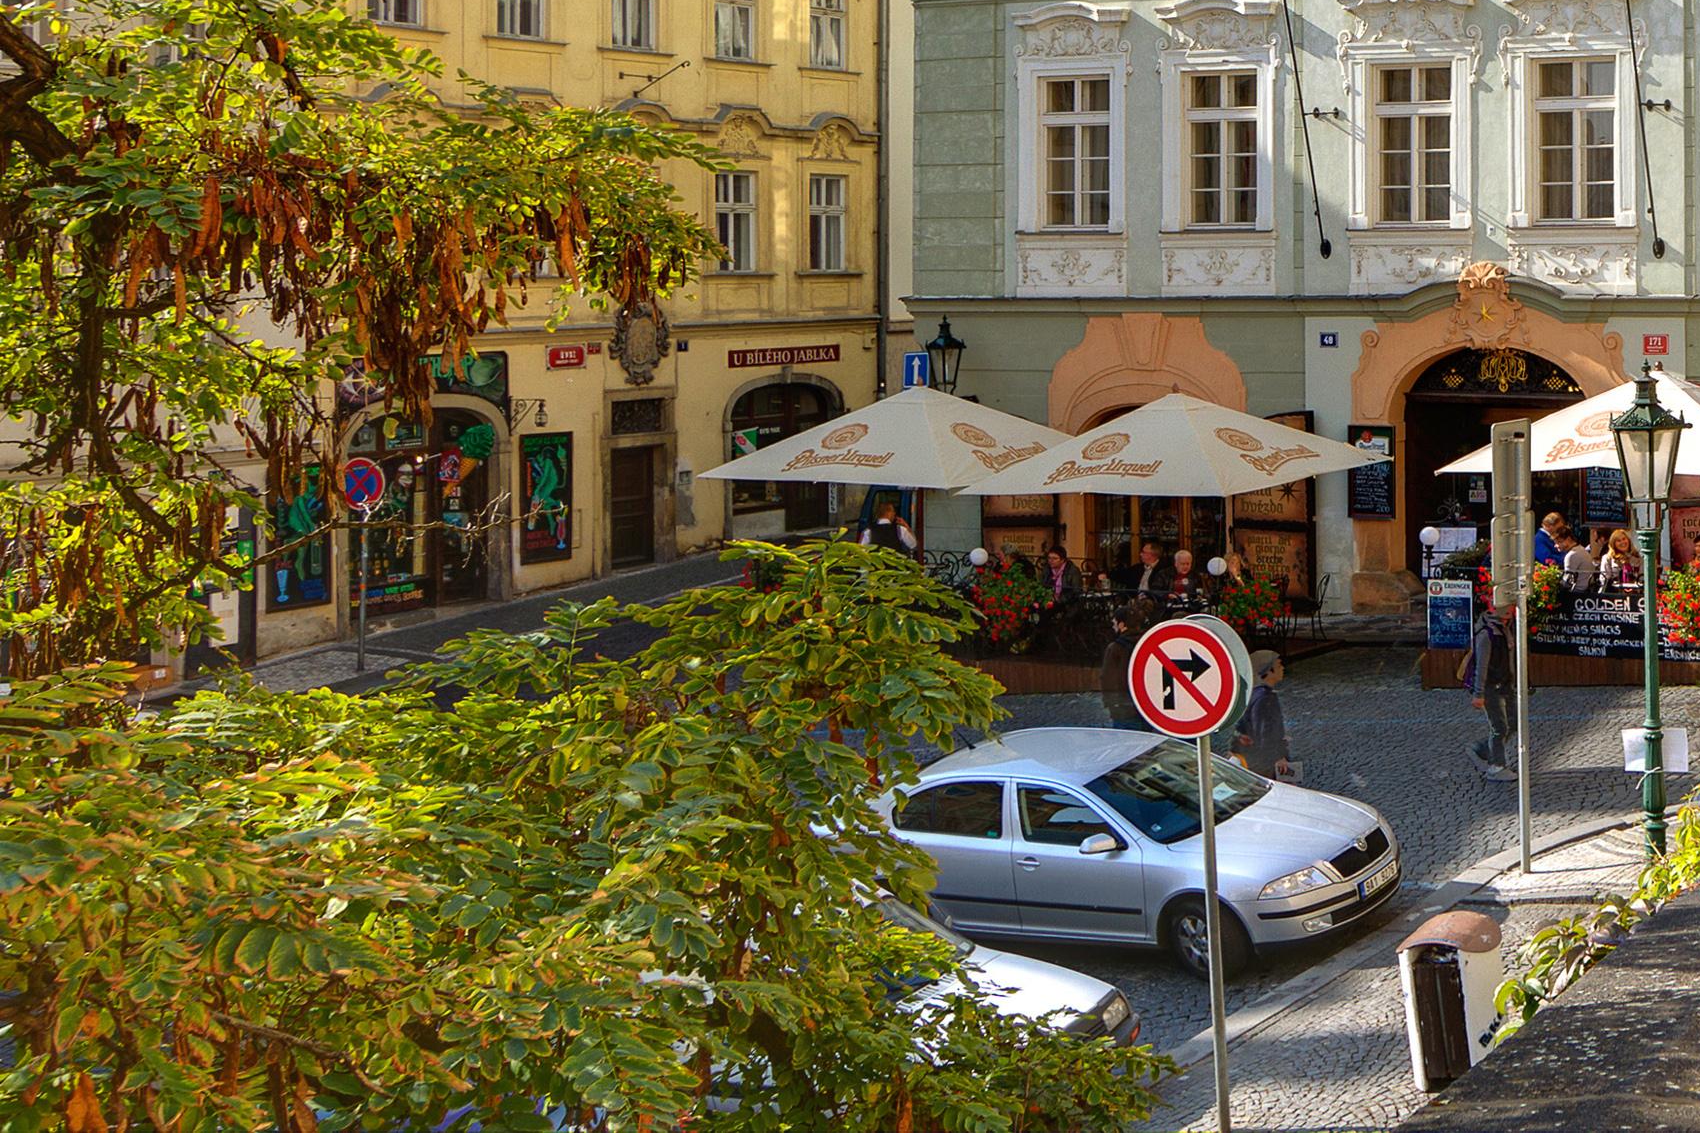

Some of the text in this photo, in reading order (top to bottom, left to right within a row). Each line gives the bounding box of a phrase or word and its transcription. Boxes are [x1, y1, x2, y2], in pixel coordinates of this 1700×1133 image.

[1323, 335, 1334, 345] 48
[1649, 336, 1662, 346] 171
[734, 347, 836, 365] U BÍLÉHO JABLKA
[1545, 438, 1613, 464] Pilsner
[781, 449, 894, 472] Pilsner Urquell
[1043, 458, 1162, 485] Pilsner Urquell
[1575, 596, 1631, 611] GOLDEN
[1573, 613, 1601, 622] CZECH
[1602, 612, 1640, 624] CUISINE
